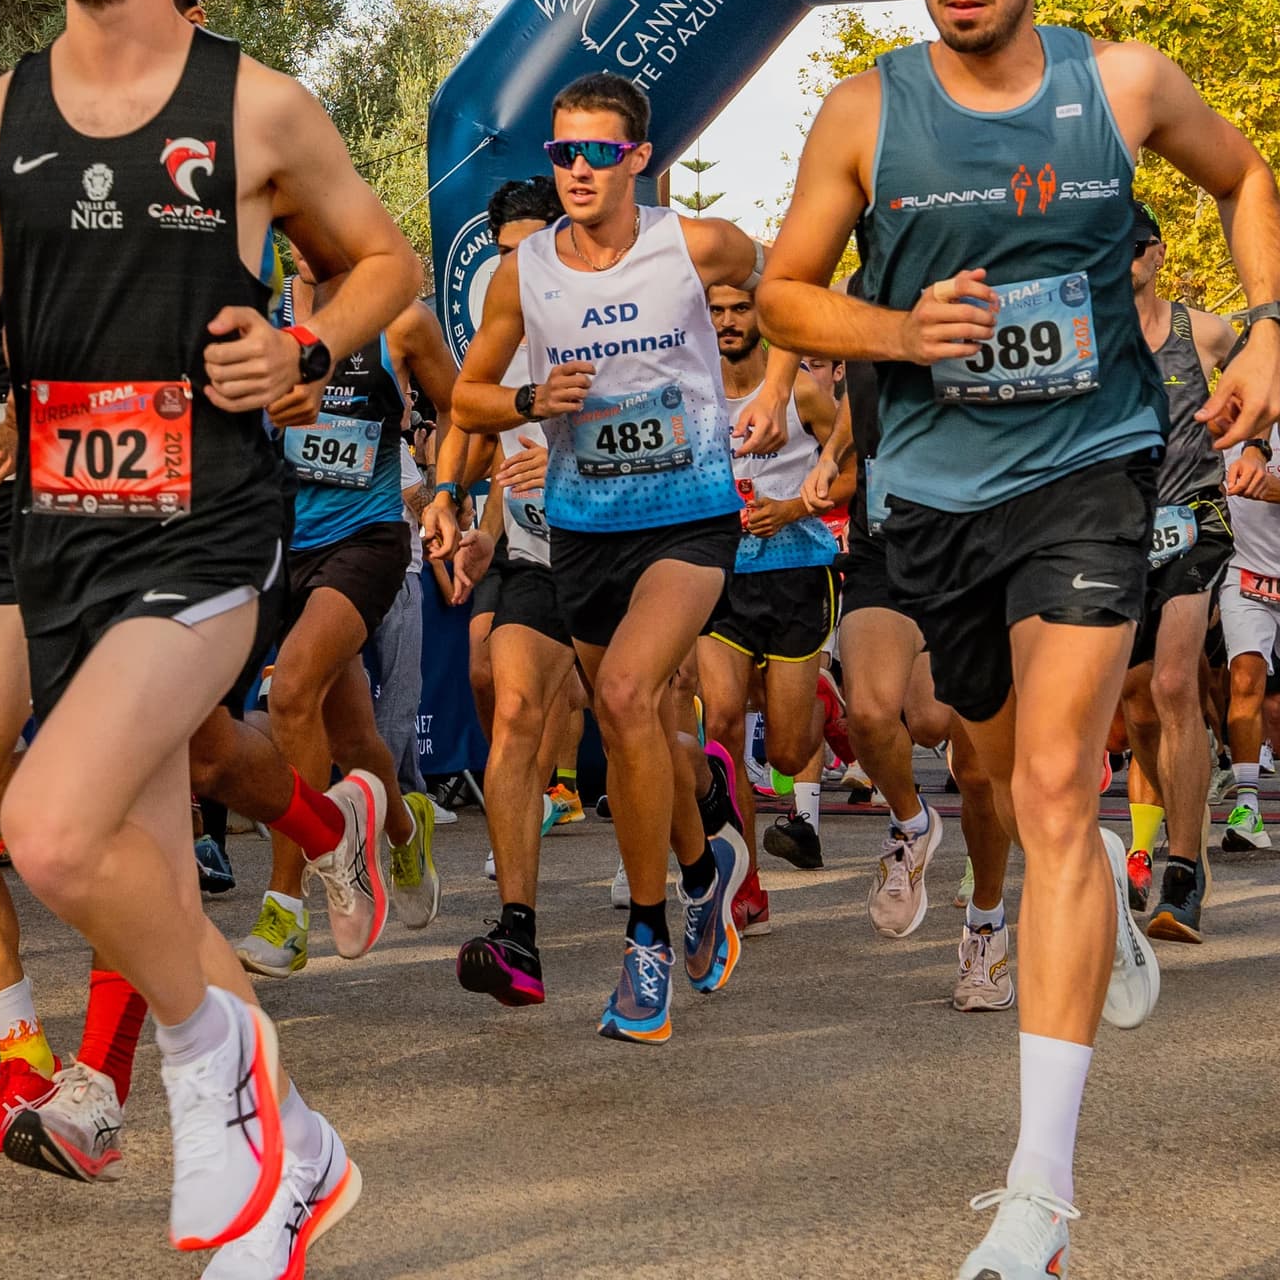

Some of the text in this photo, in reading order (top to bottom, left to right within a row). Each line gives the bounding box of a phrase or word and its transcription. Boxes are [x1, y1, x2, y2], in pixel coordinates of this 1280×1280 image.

[901, 188, 1007, 208] RUNNING
[1058, 189, 1120, 201] PASSION
[1061, 178, 1120, 191] CYCLE
[71, 209, 124, 230] NICE
[148, 203, 227, 224] CAVIGAL
[581, 302, 639, 328] ASD
[964, 320, 1062, 374] 589
[1072, 315, 1092, 361] 2024
[302, 433, 358, 468] 594
[596, 418, 664, 455] 483
[57, 429, 148, 480] 702
[164, 431, 183, 480] 2024
